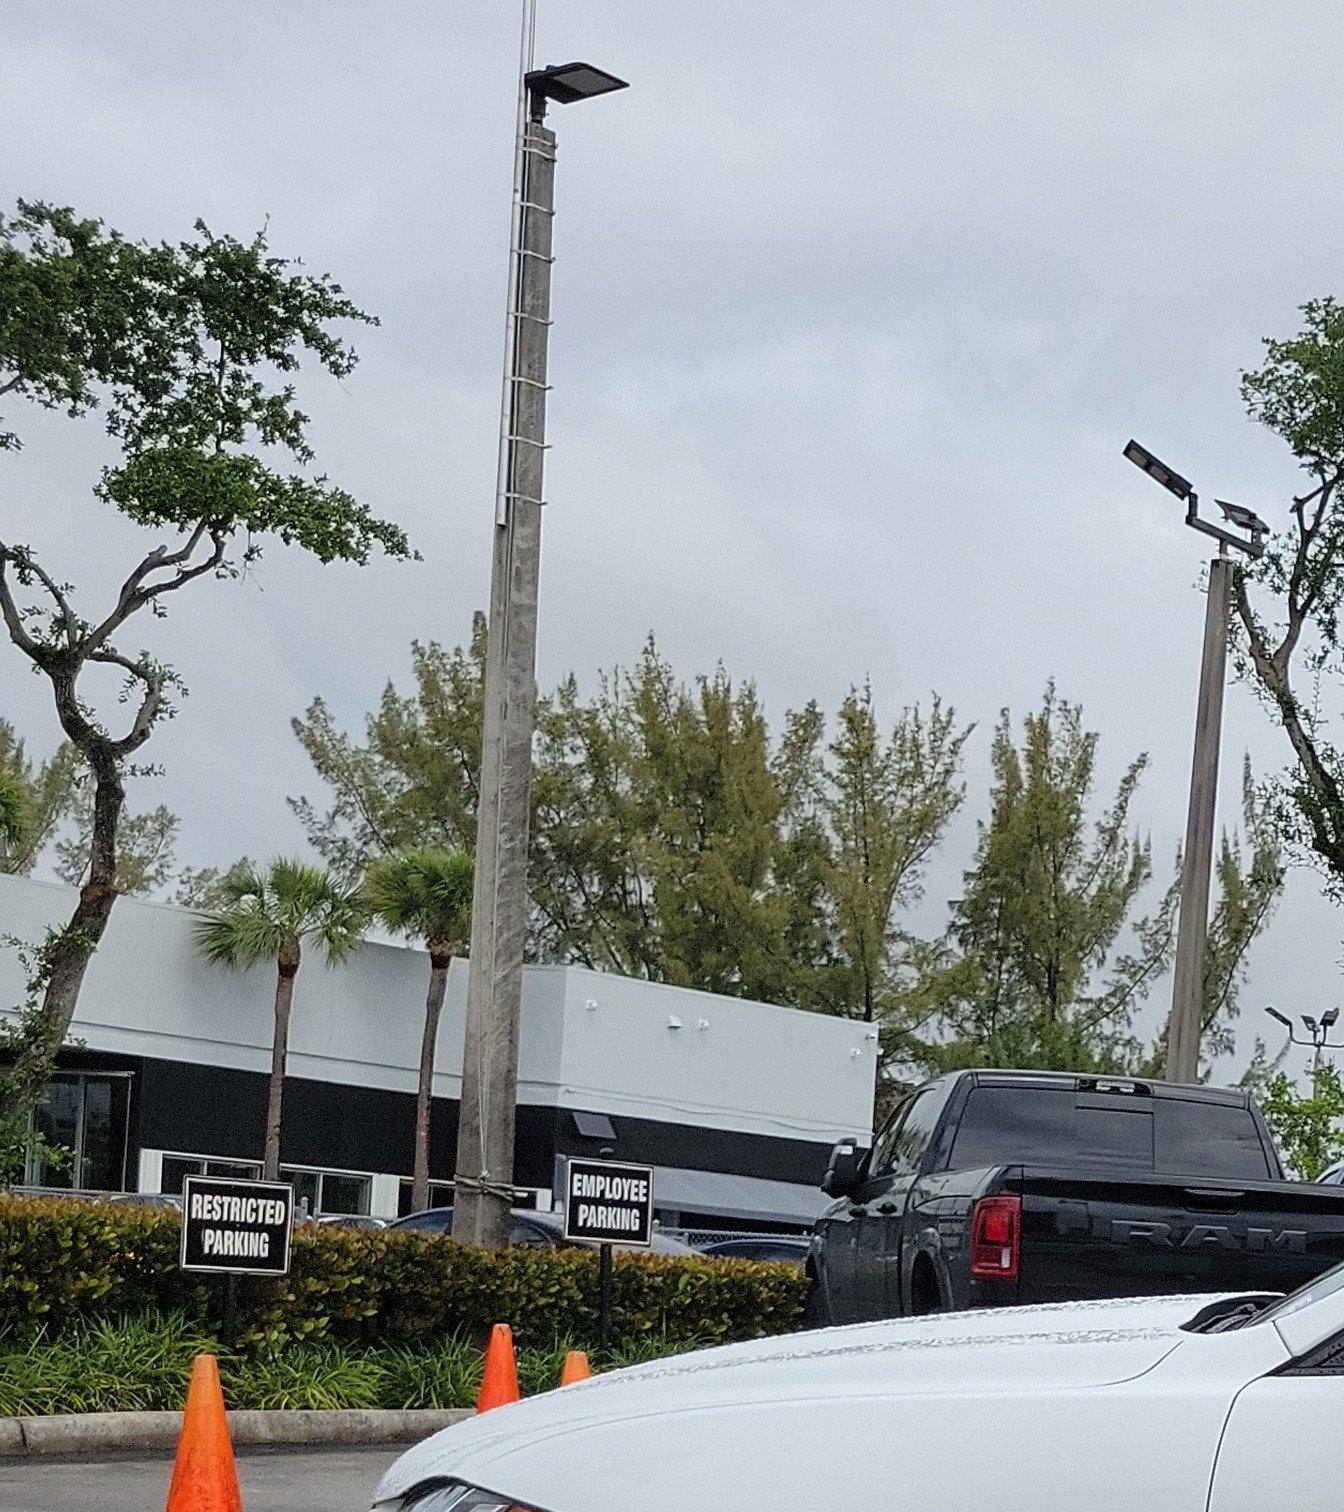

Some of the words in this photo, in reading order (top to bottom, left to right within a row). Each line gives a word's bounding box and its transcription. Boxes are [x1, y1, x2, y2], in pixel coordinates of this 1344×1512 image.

[572, 1173, 648, 1203] EMPLOYEE
[191, 1193, 286, 1226] RESTRICTED
[577, 1203, 641, 1232] PARKING
[203, 1228, 270, 1258] PARKING
[1110, 1219, 1309, 1254] RAM
